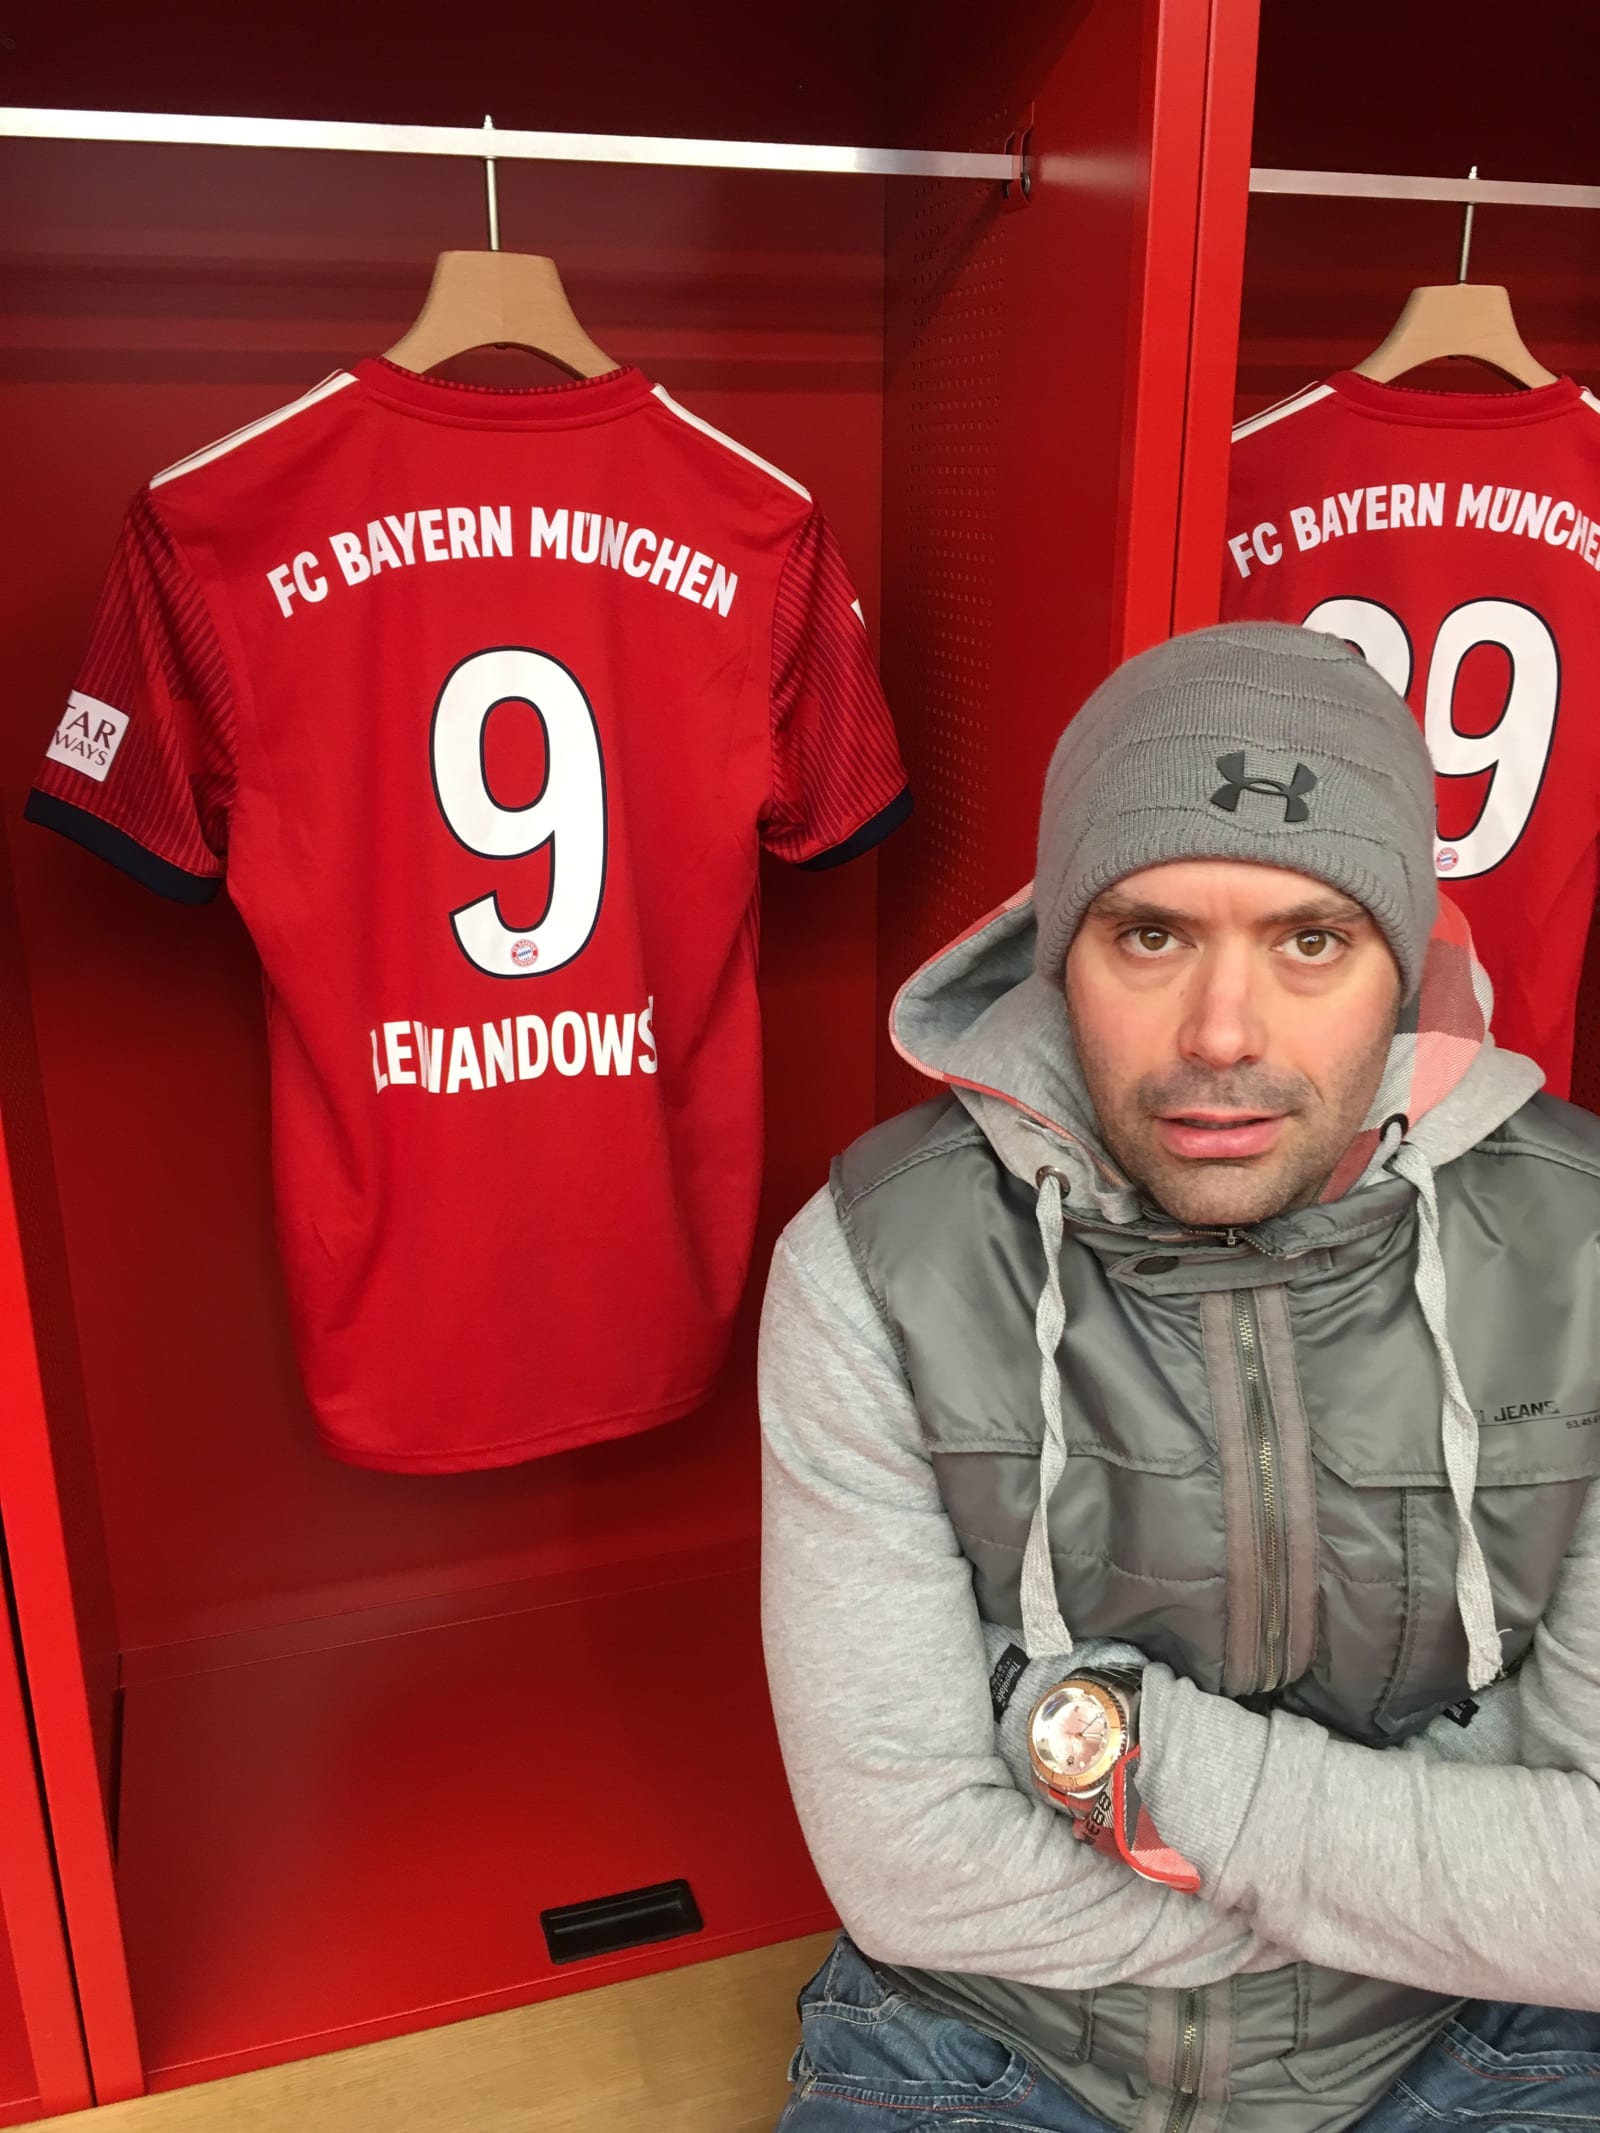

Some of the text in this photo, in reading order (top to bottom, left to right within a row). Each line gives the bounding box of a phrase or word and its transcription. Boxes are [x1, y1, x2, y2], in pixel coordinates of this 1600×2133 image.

[1228, 523, 1282, 577] FC
[1290, 483, 1446, 552] BAYERN
[266, 505, 739, 618] FC BAYERN MÜNCHEN
[55, 730, 108, 766] WAYS
[66, 704, 117, 749] AR
[430, 645, 608, 980] 9
[1494, 1400, 1560, 1422] JEANS
[995, 1661, 1021, 1703] Thinsulate
